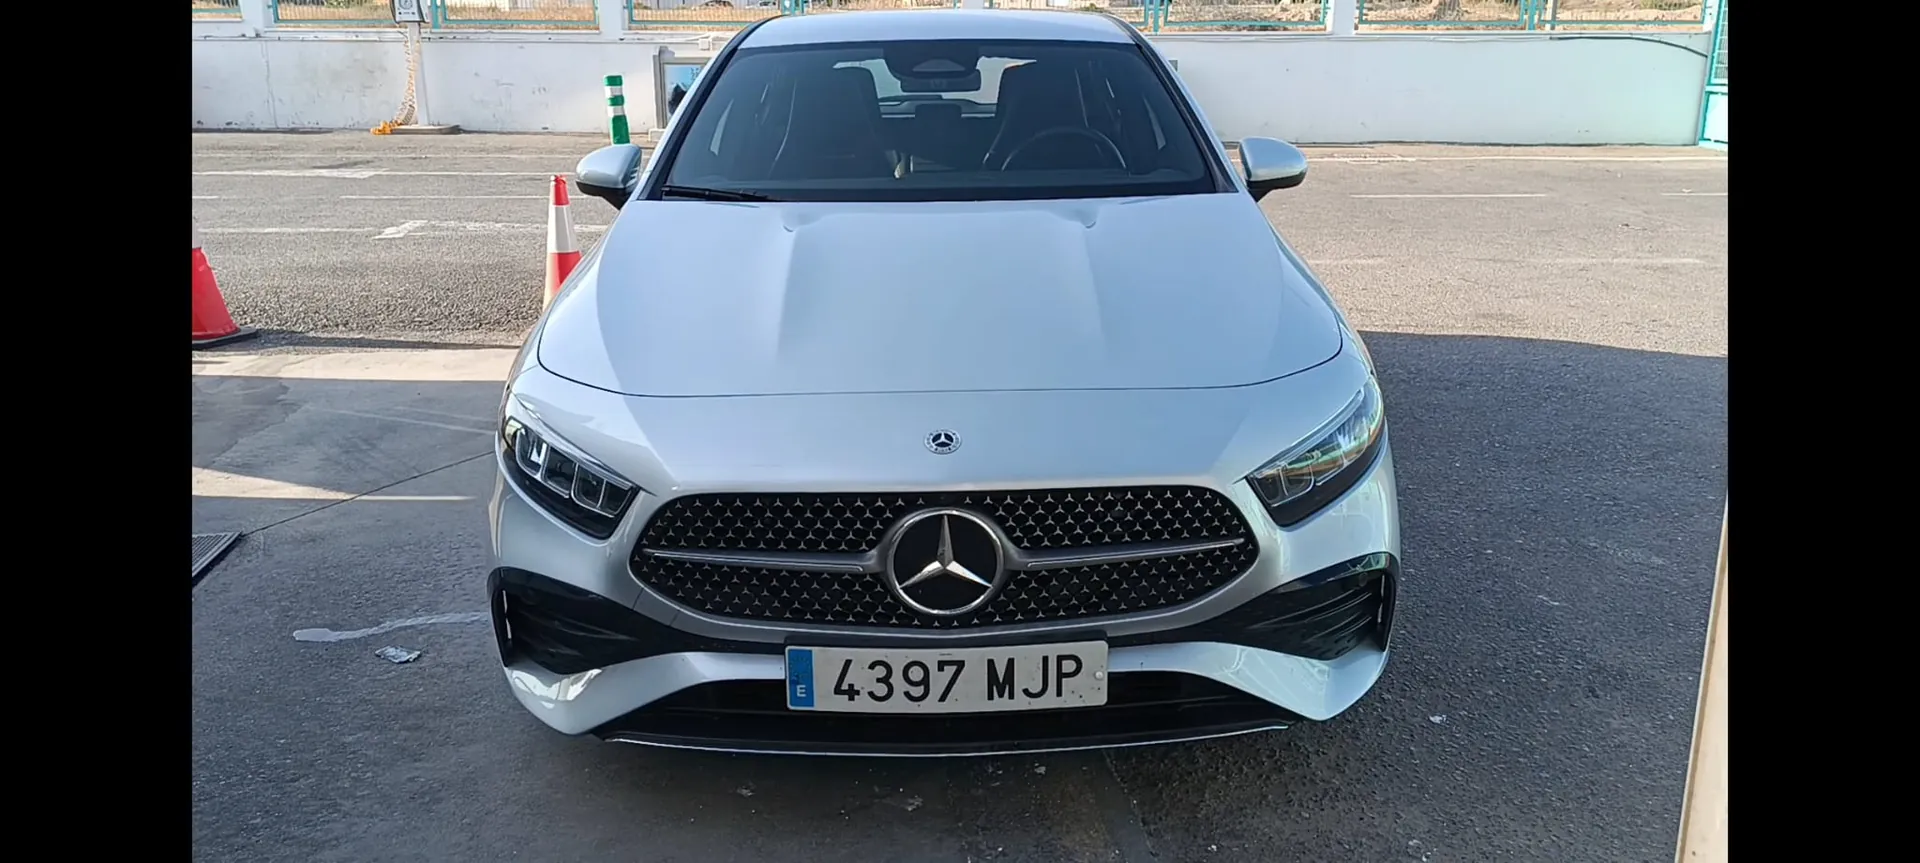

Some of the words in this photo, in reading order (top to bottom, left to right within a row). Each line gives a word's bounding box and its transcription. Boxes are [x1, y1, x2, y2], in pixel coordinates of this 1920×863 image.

[796, 684, 807, 697] E
[833, 658, 966, 703] 4397
[986, 654, 1083, 702] MJP
